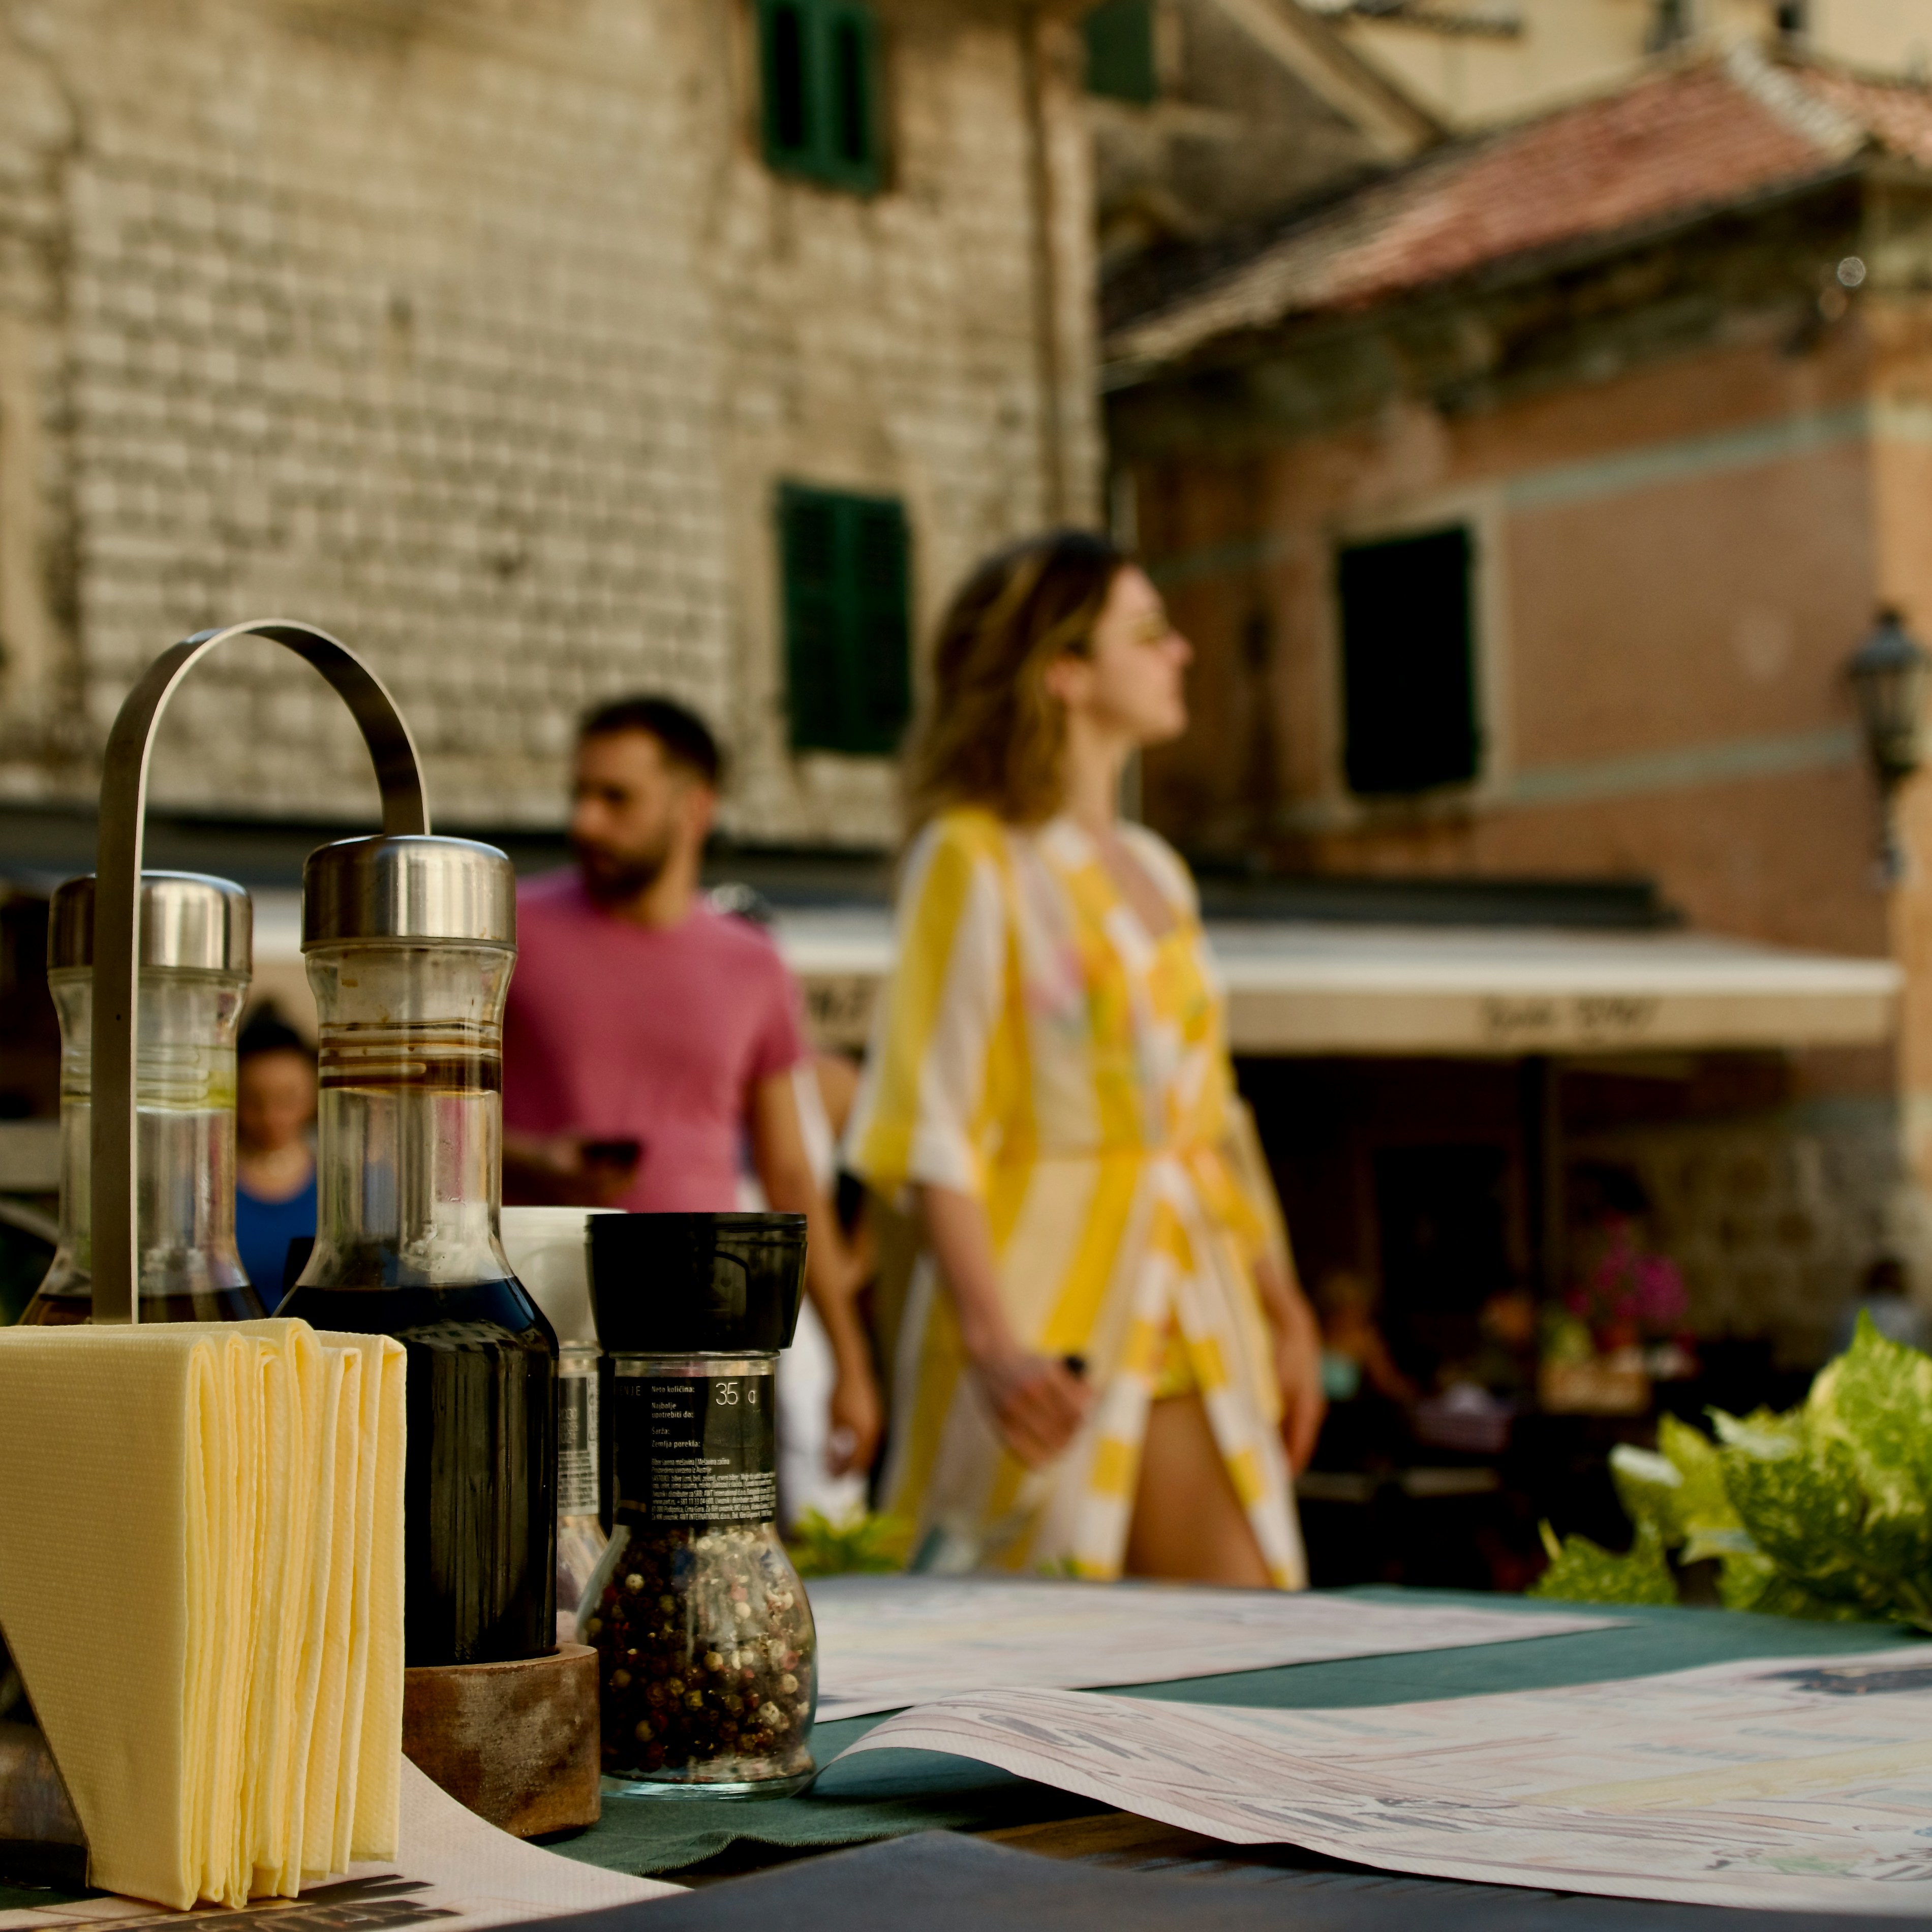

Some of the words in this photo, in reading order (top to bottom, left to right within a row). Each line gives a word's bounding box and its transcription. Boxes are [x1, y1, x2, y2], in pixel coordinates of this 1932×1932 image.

[716, 1382, 738, 1405] 35
[652, 1402, 677, 1410] Najbolje
[652, 1411, 682, 1419] upotrebiti
[652, 1440, 672, 1449] Zemlja
[673, 1440, 701, 1449] porekla:
